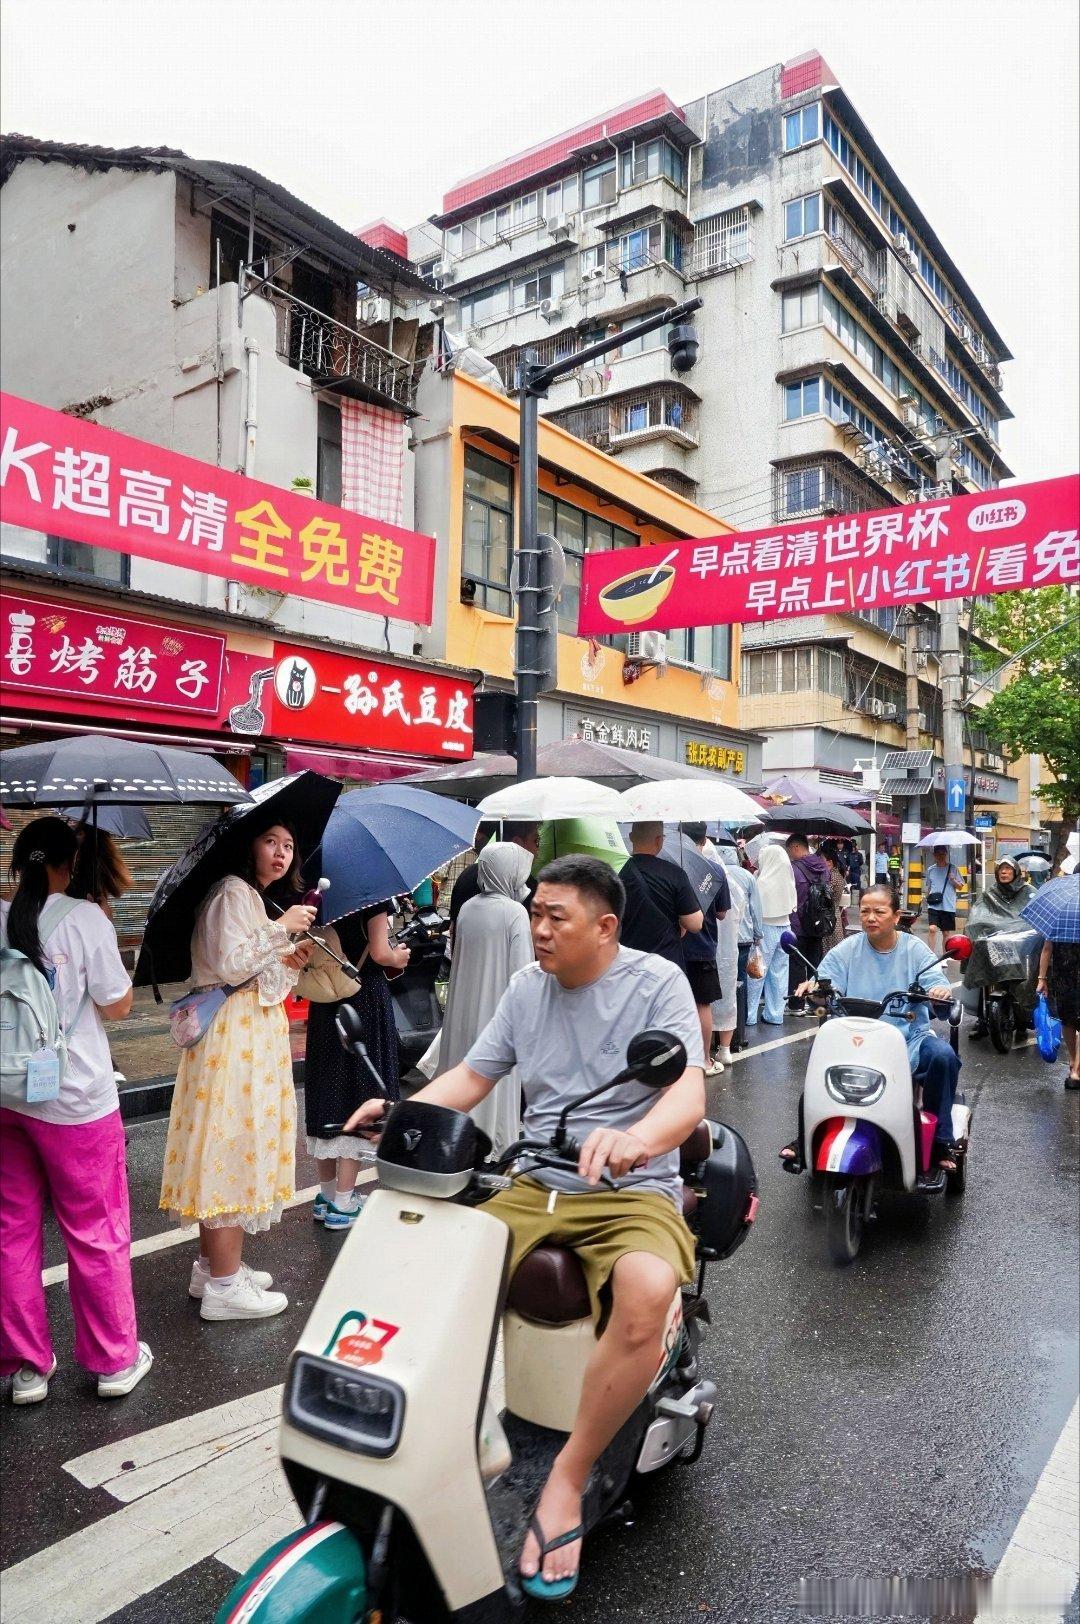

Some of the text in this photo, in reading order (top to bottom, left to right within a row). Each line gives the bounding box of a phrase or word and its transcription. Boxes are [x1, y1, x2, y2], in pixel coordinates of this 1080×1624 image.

[975, 506, 1018, 526] 小红书
[689, 505, 950, 580] 早点看清世界杯
[581, 717, 651, 751] 高金鲜肉店
[688, 741, 745, 775] 张氏农副产品
